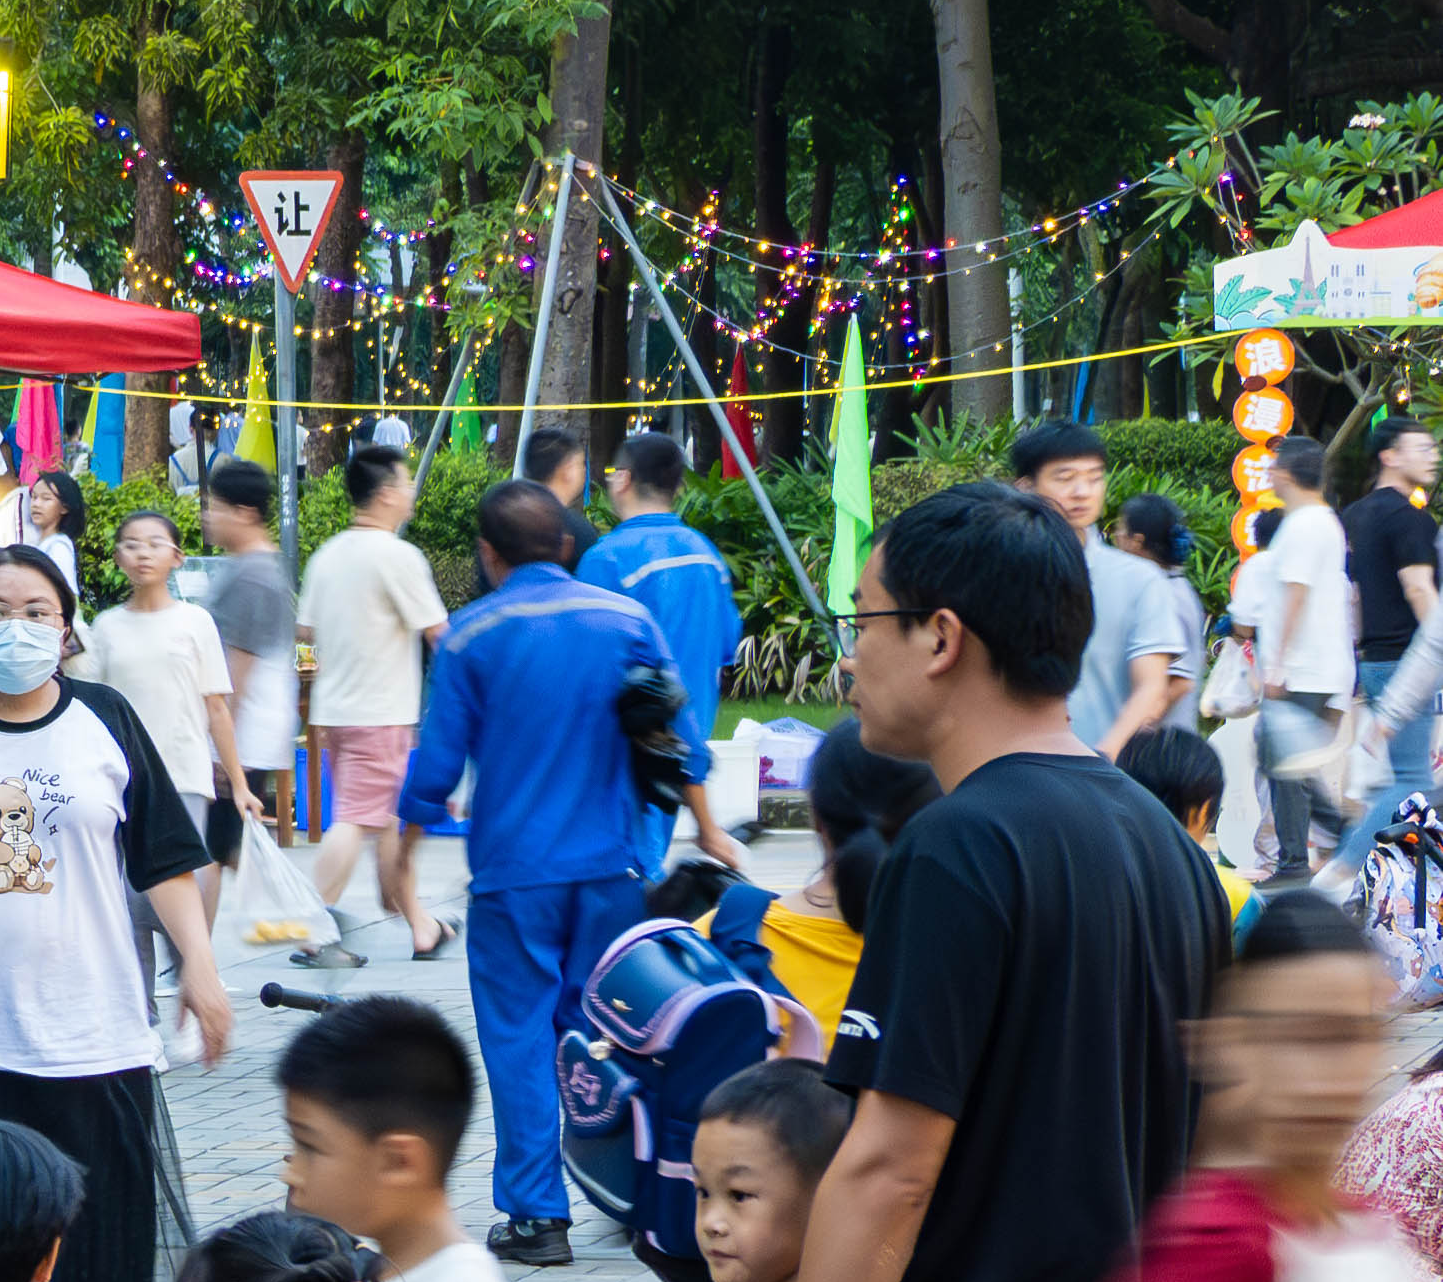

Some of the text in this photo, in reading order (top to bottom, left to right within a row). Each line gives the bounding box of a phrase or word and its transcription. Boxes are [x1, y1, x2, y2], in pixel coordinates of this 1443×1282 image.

[274, 191, 312, 236] 让
[23, 768, 61, 787] Nice
[40, 788, 76, 806] bear
